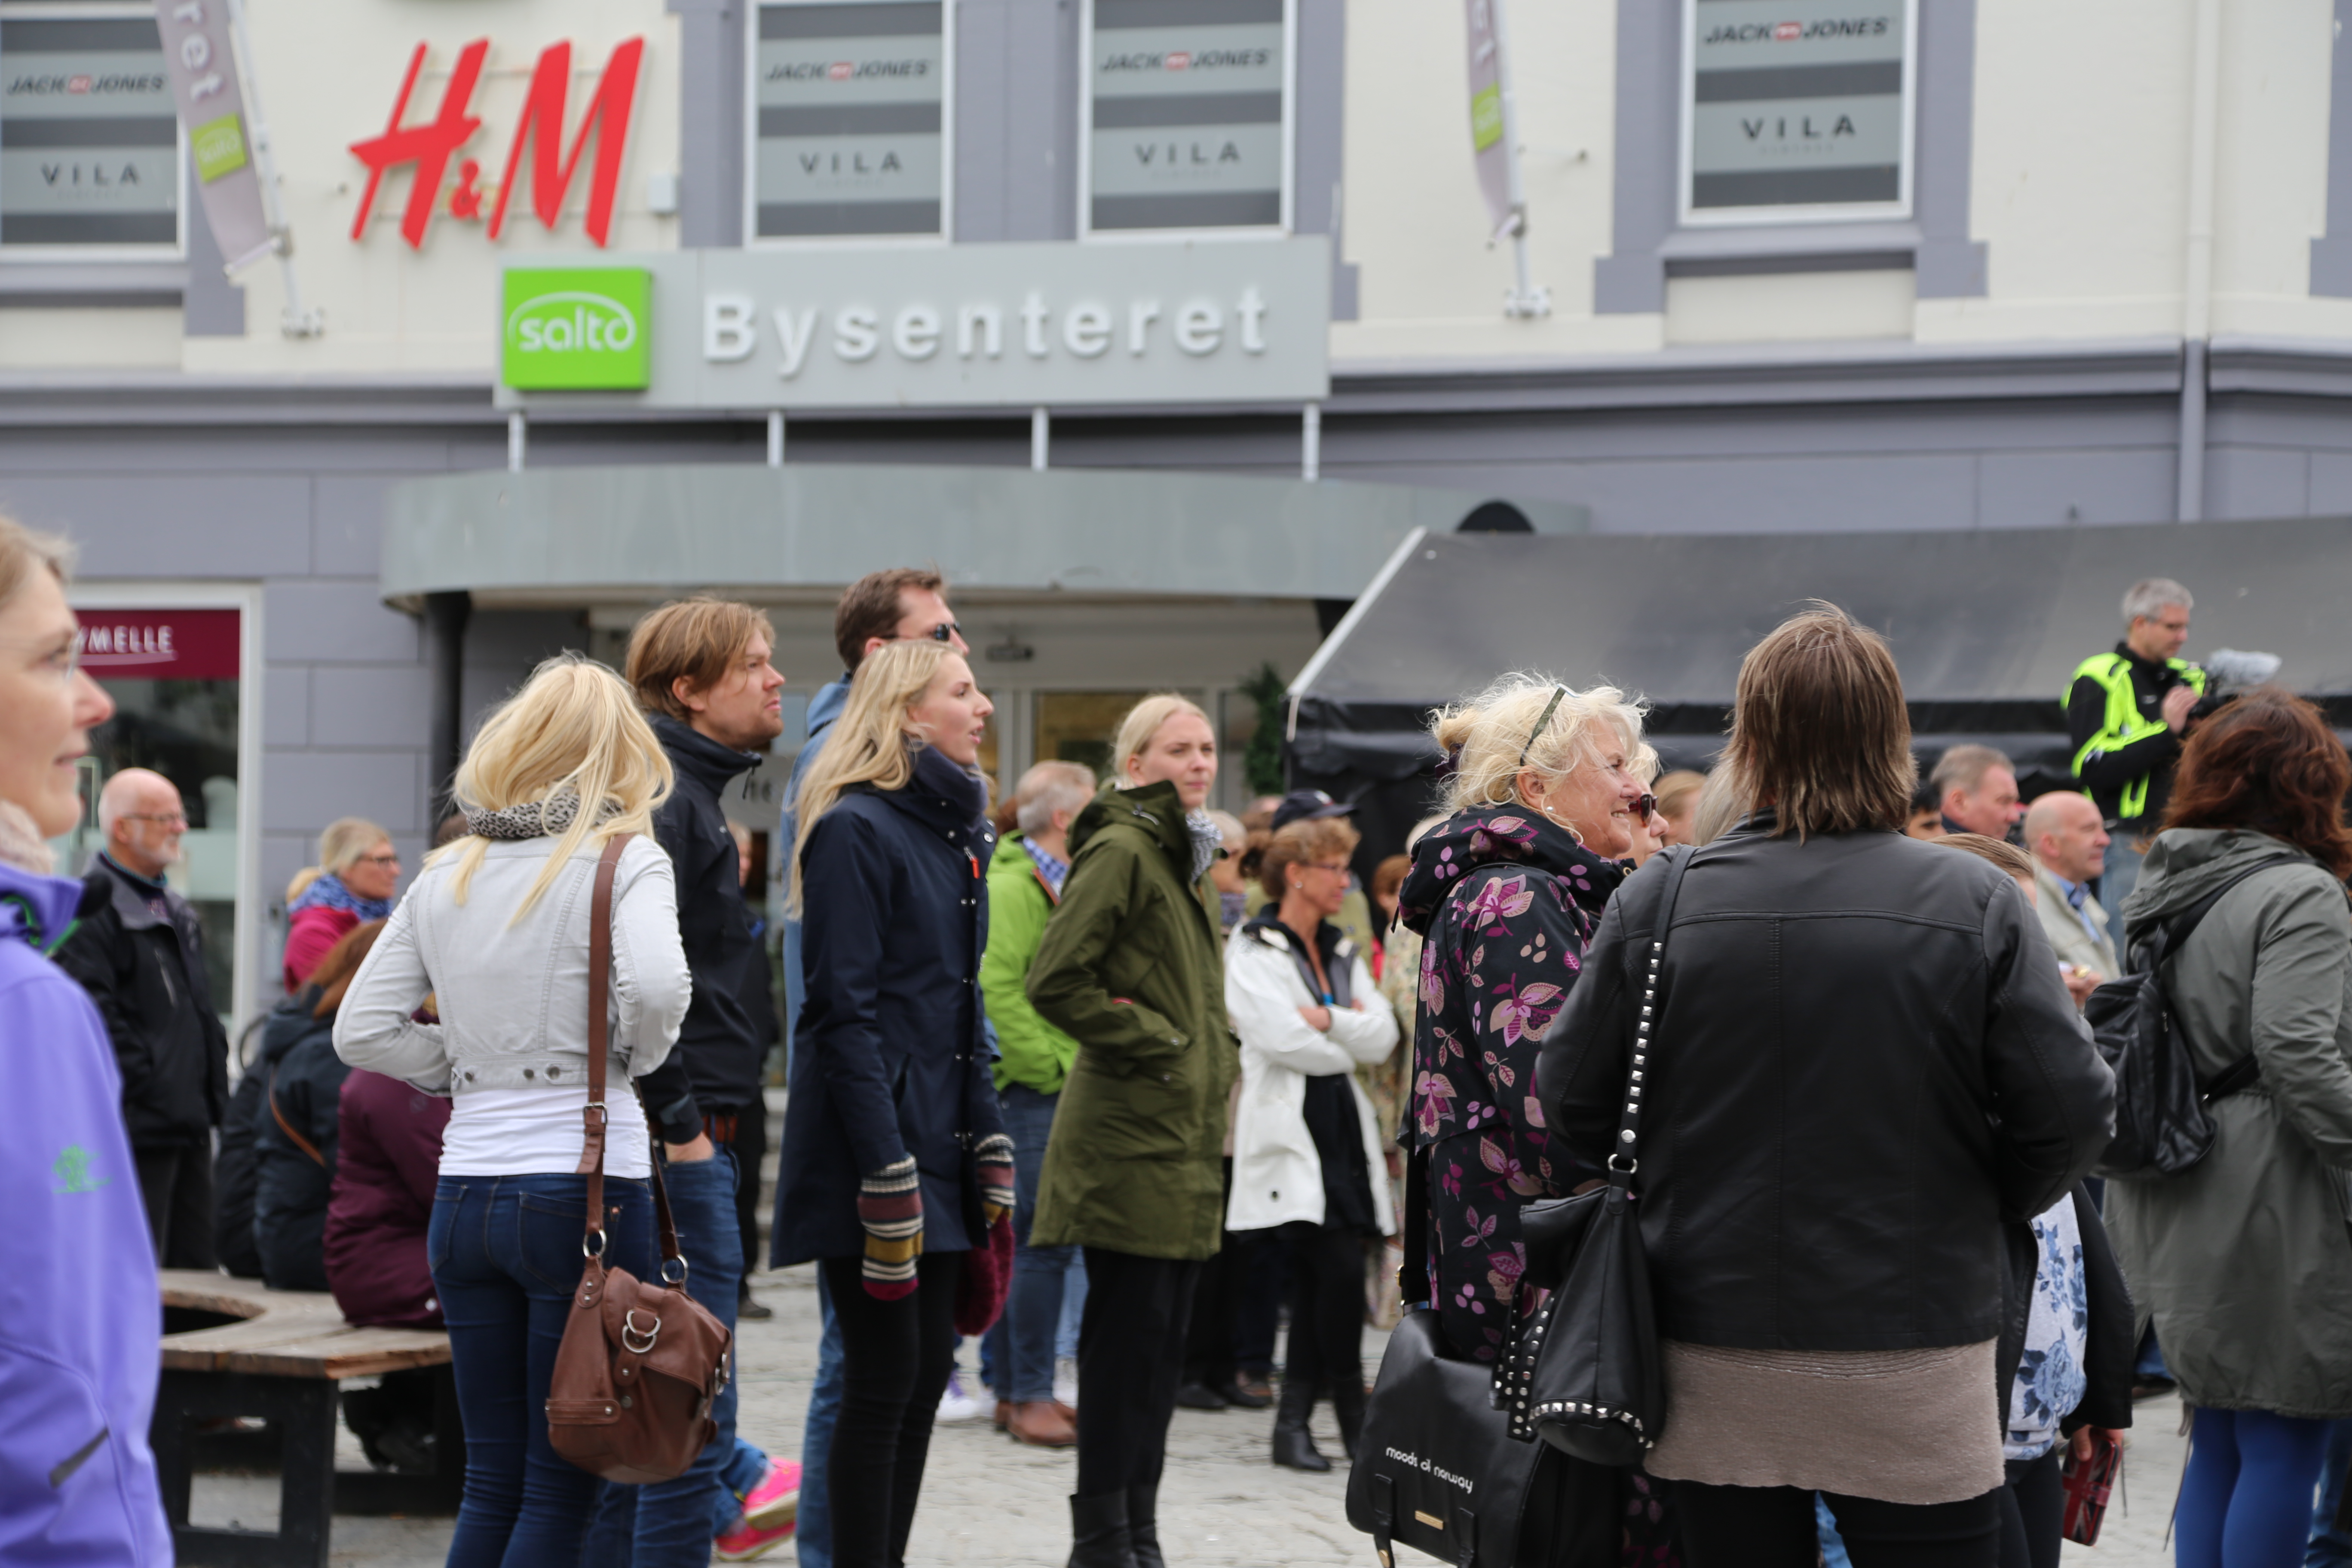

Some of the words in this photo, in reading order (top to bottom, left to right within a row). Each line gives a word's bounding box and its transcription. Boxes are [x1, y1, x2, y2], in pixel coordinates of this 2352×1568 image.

[1704, 23, 1773, 44] JACK
[1803, 16, 1890, 40] JONES
[764, 62, 826, 82] JACK
[851, 59, 931, 80] JONES
[1099, 52, 1163, 73] JACK
[1190, 49, 1269, 68] JONES
[6, 74, 67, 95] JACK
[90, 73, 168, 94] JONES
[1742, 113, 1857, 142] VILA
[347, 35, 646, 250] H&M
[1134, 141, 1241, 165] VILA
[40, 161, 141, 186] VILA
[798, 151, 902, 176] VILA
[512, 297, 637, 353] salto
[702, 285, 1268, 381] Bysenteret
[1386, 1446, 1418, 1467] moods
[1433, 1466, 1473, 1494] norway
